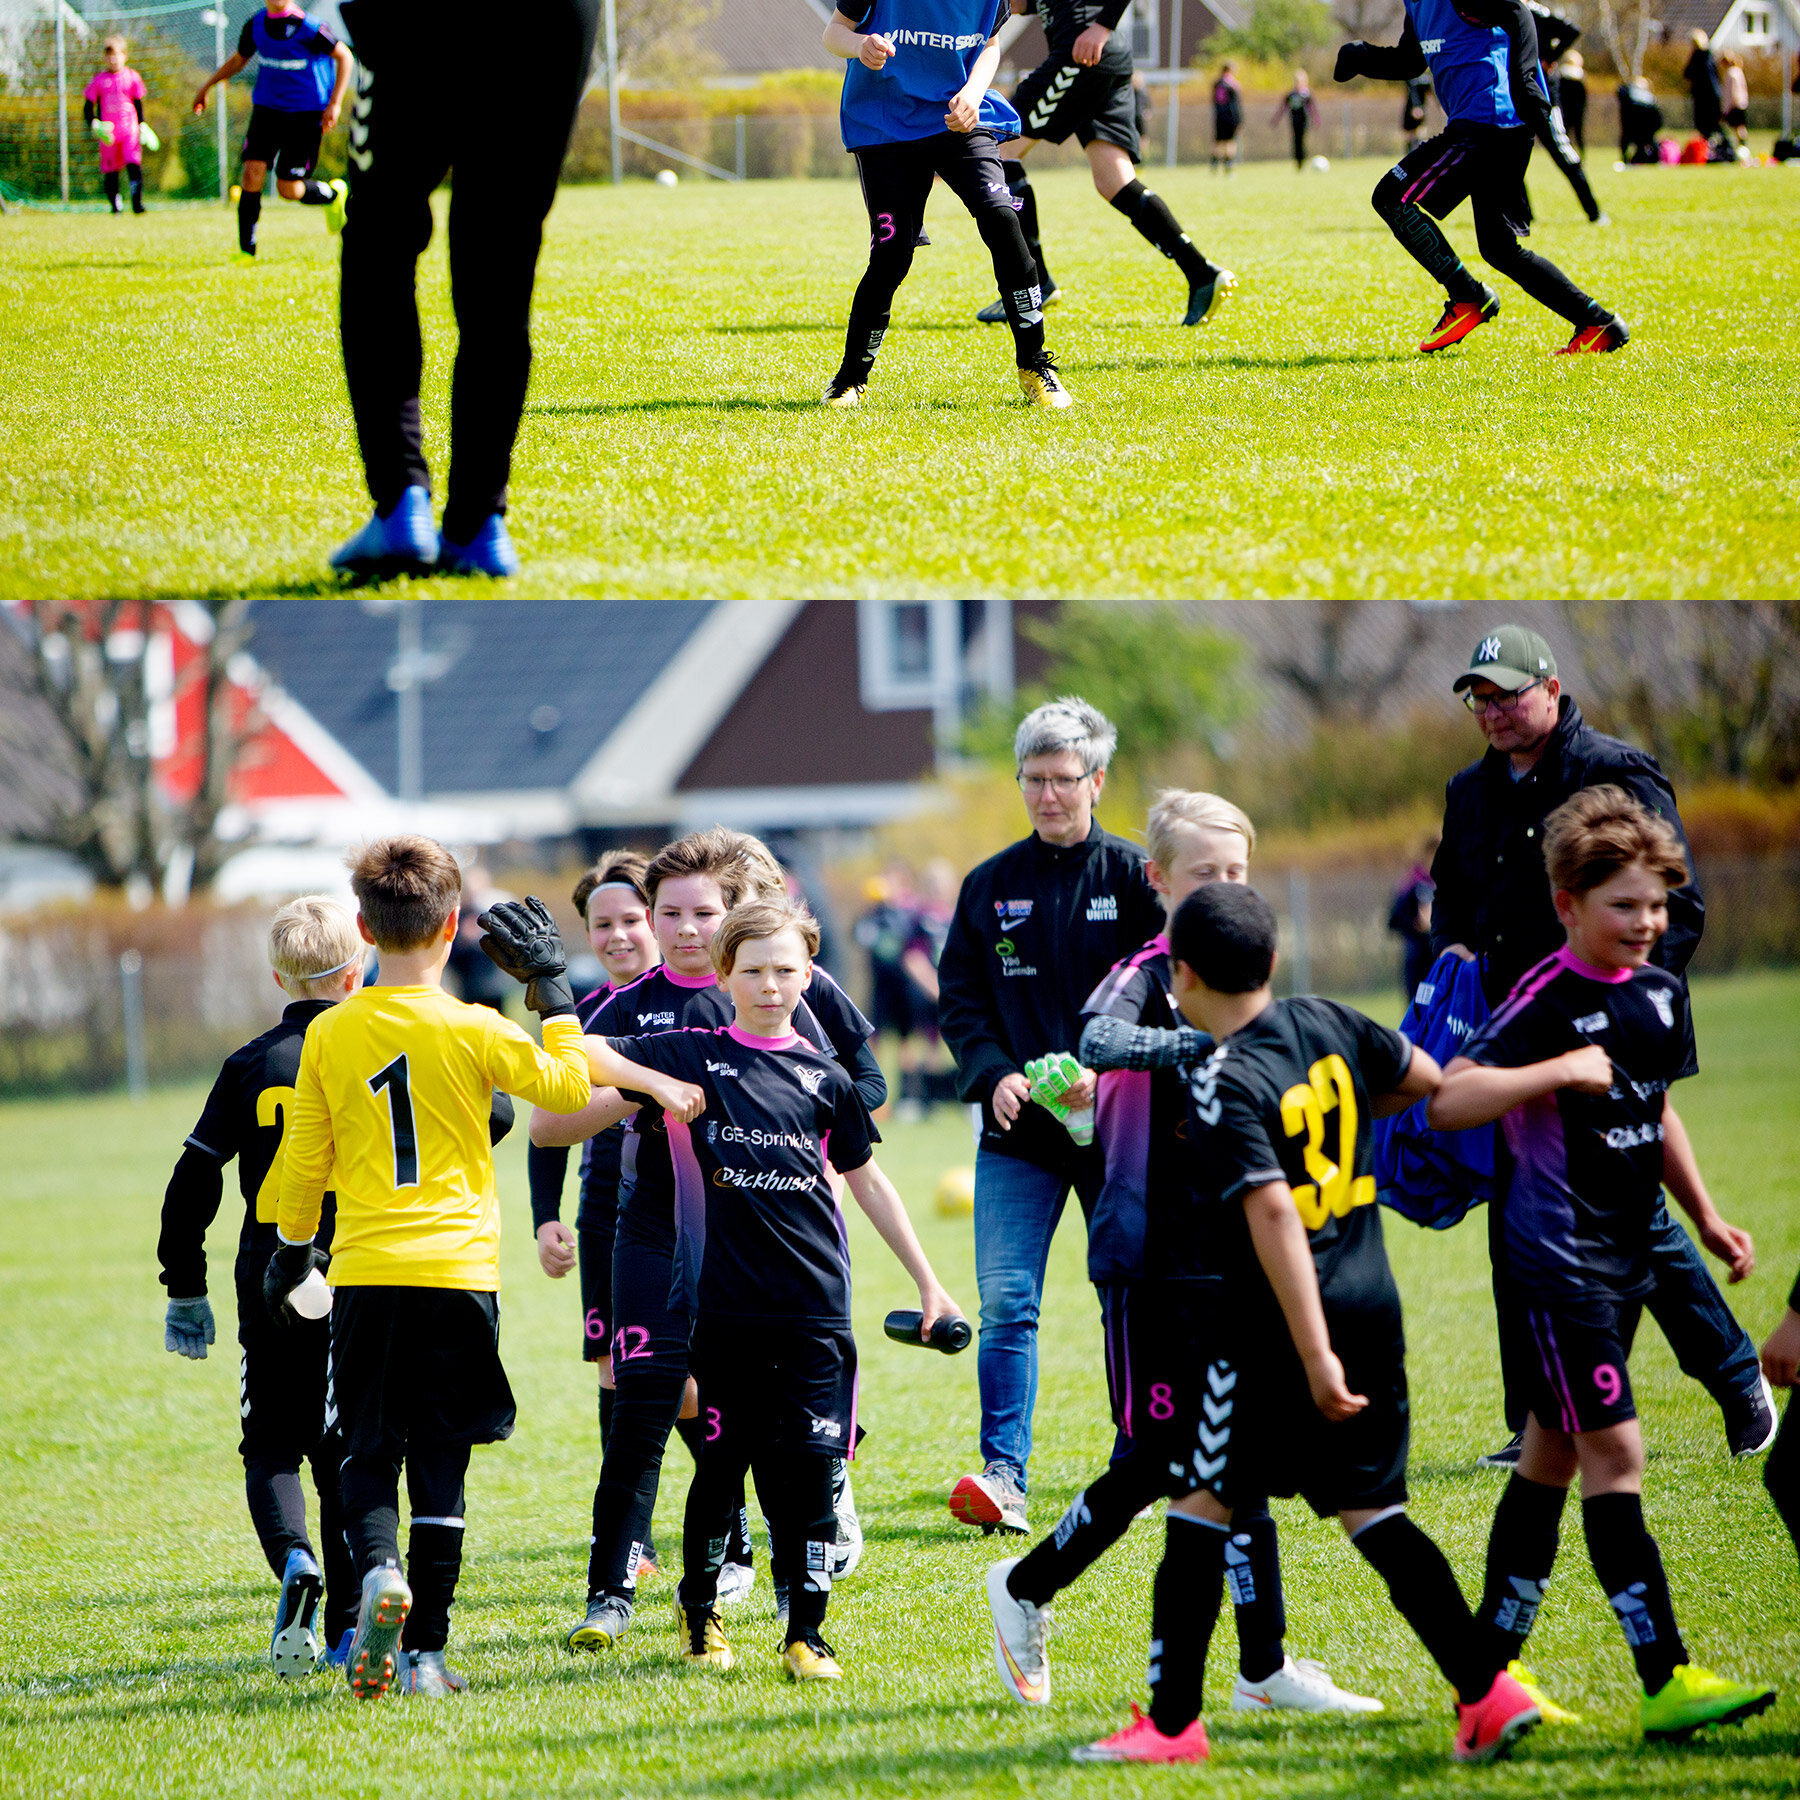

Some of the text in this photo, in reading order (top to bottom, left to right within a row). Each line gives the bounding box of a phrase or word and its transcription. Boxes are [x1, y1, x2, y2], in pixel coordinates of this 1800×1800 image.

[877, 211, 896, 243] 3
[1013, 288, 1032, 313] INTER
[867, 329, 884, 350] INTER
[1478, 636, 1502, 661] NY
[652, 1011, 675, 1020] INTER
[653, 1018, 675, 1026] SPORT
[365, 1052, 421, 1191] 1
[1279, 1053, 1377, 1231] 32
[585, 1307, 606, 1340] 6
[615, 1325, 654, 1362] 12
[1592, 1362, 1622, 1406] 9
[1149, 1382, 1175, 1420] 8
[705, 1406, 722, 1441] 3
[626, 1540, 641, 1570] INTER
[806, 1540, 824, 1570] INTER
